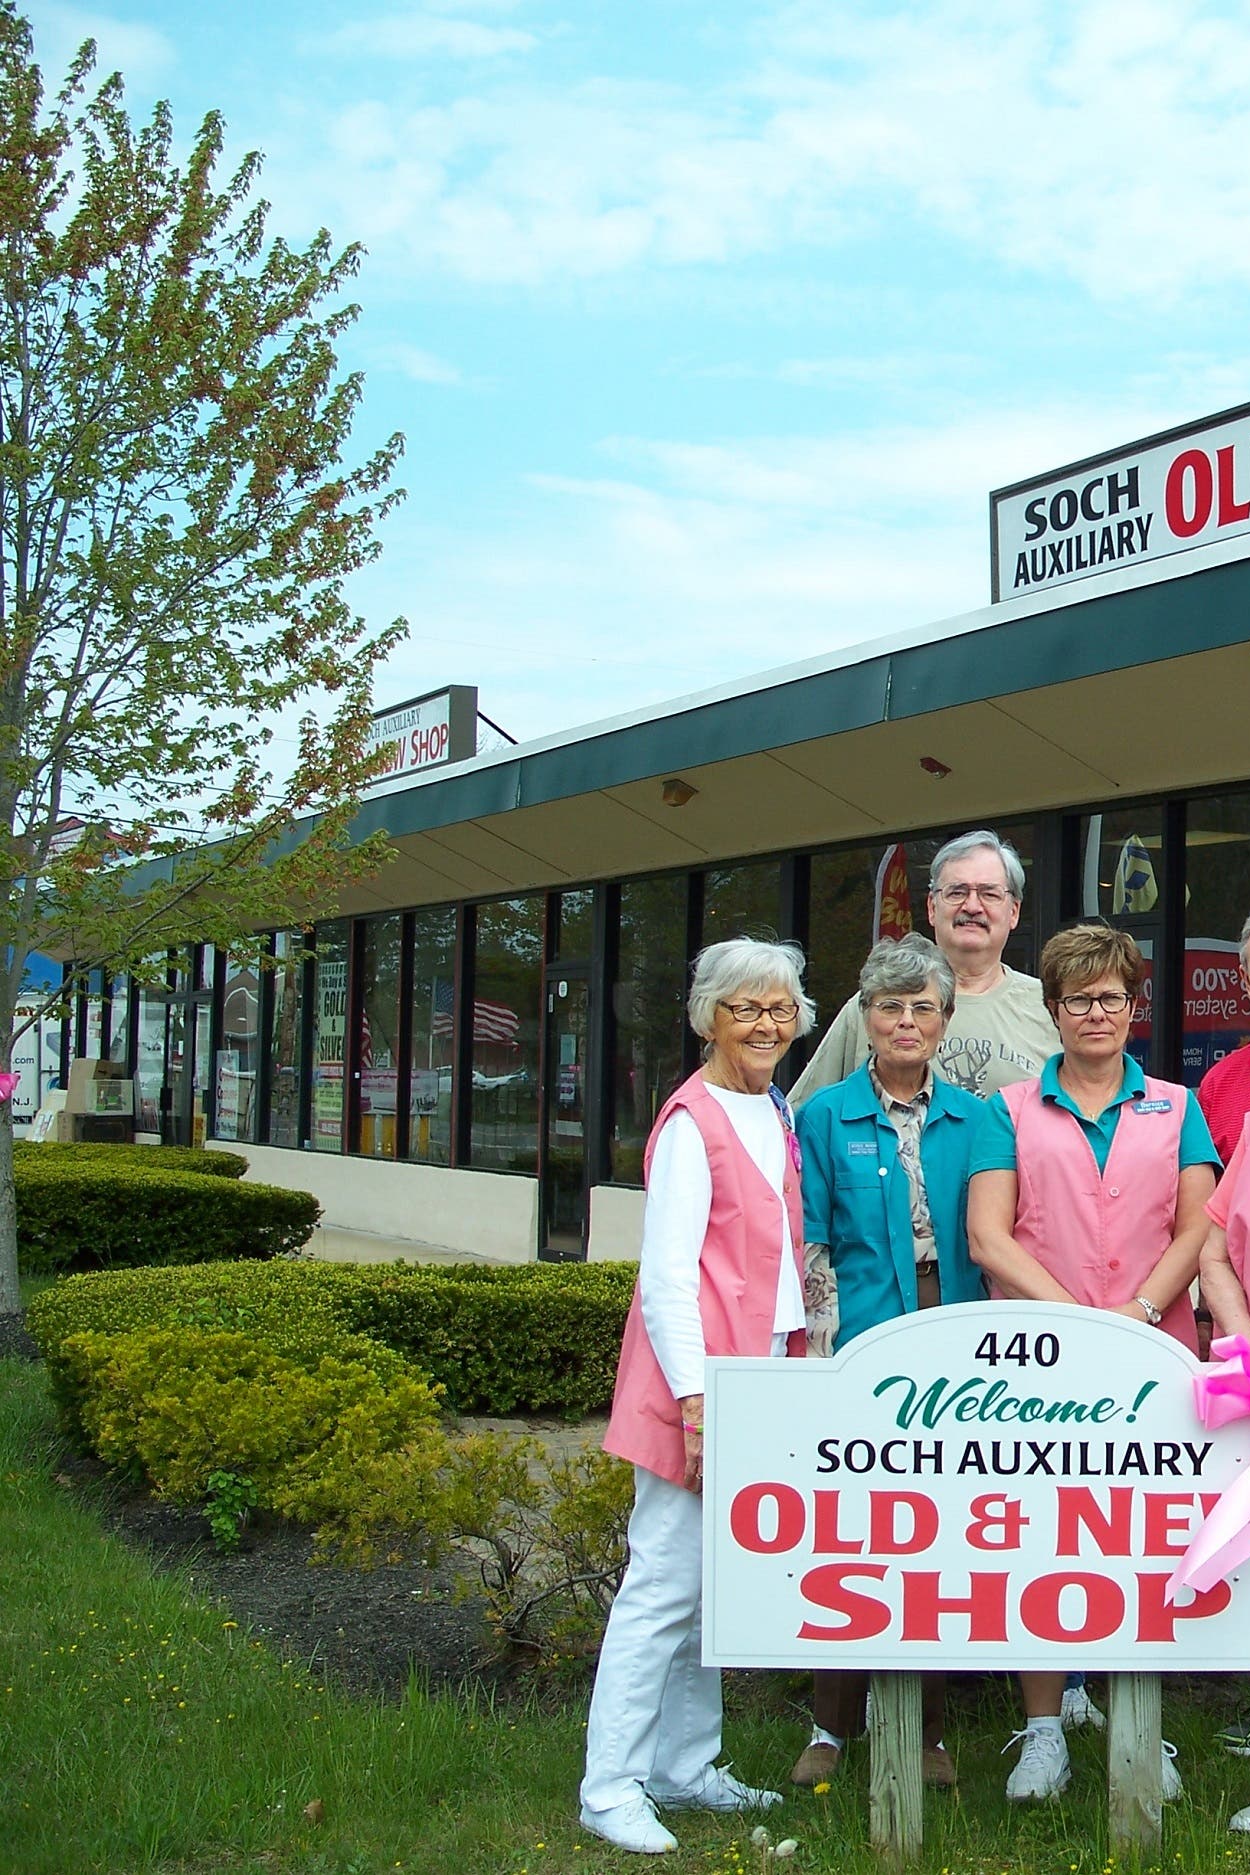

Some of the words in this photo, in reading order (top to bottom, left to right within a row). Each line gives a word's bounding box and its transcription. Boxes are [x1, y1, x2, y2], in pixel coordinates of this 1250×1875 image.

[1024, 465, 1140, 541] SOCH
[1014, 512, 1153, 588] AUXILIARY
[382, 706, 421, 737] AUXILIARY
[410, 723, 449, 766] SHOP
[13, 1056, 34, 1064] .com
[1000, 1043, 1036, 1073] LIFE
[974, 1332, 1060, 1367] 440
[873, 1375, 1159, 1430] Welcome!
[816, 1439, 943, 1475] SOCH
[957, 1441, 1213, 1477] AUXILIARY
[730, 1482, 939, 1555] OLD
[965, 1493, 1031, 1550] &
[796, 1563, 1233, 1643] SHOP
